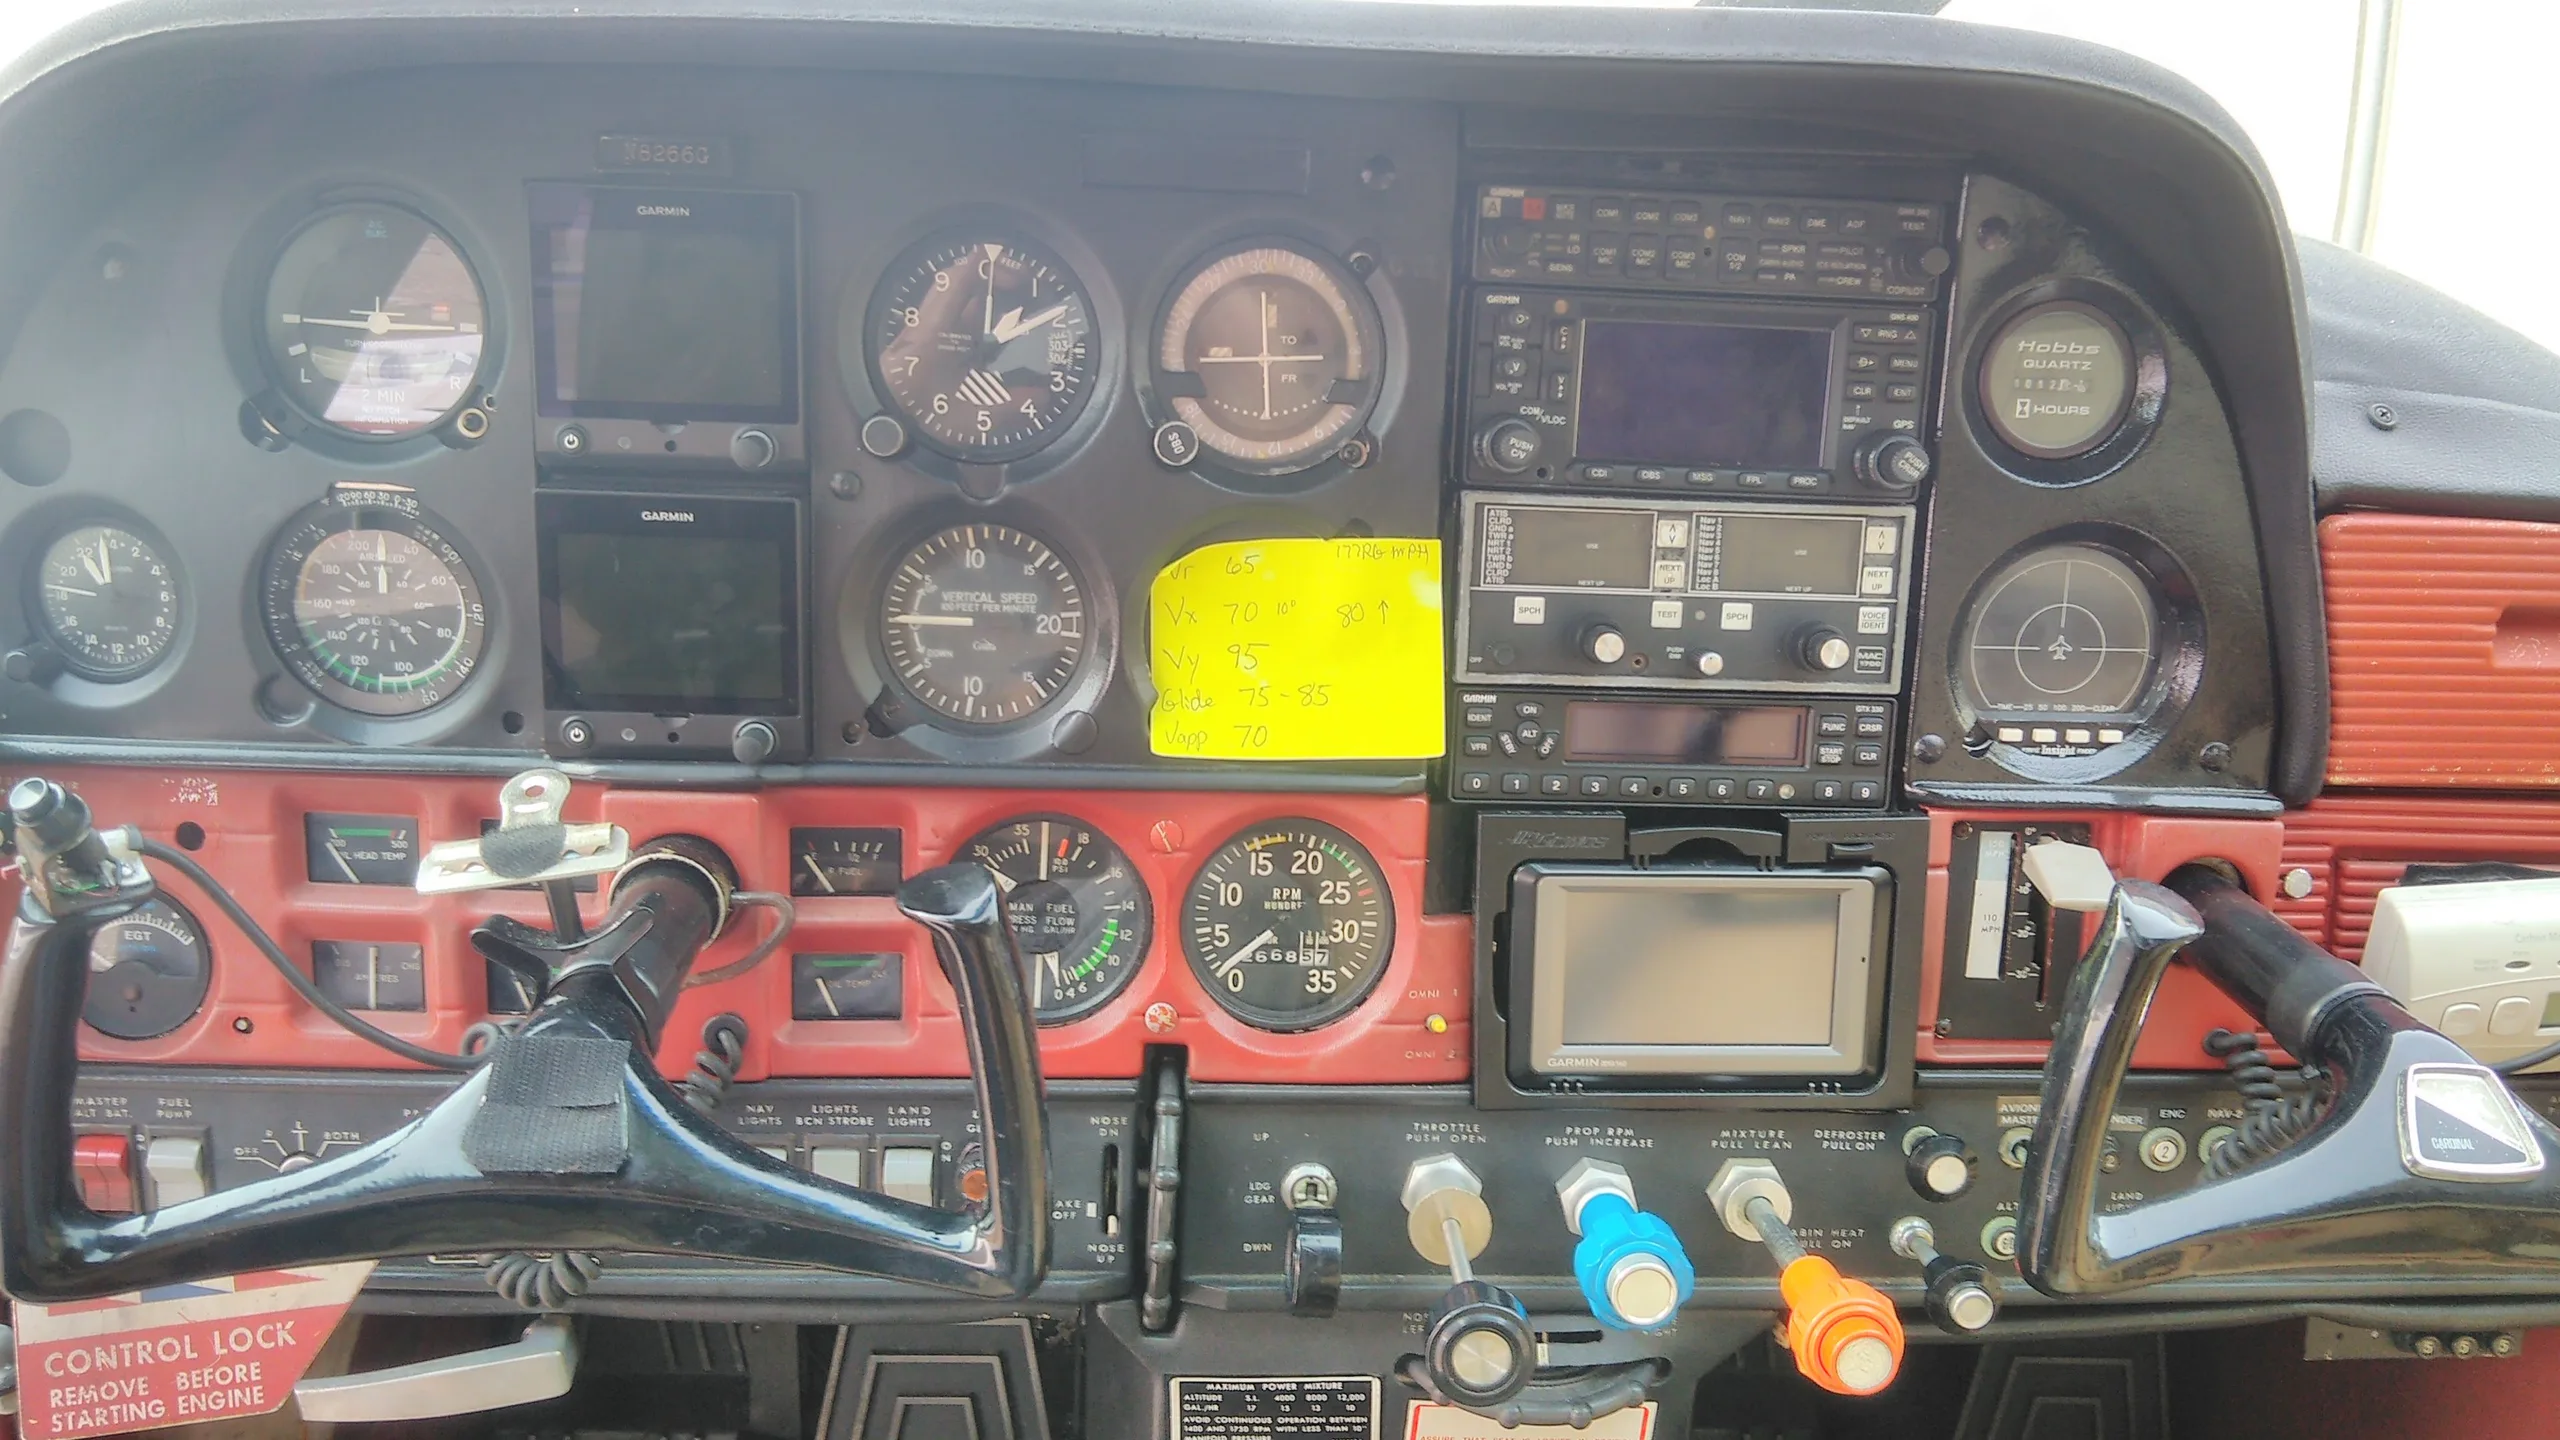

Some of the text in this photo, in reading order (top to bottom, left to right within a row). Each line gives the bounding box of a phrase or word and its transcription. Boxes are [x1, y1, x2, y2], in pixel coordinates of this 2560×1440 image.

[624, 142, 710, 164] N8266G
[637, 205, 690, 216] GARMIN
[935, 271, 950, 292] 9
[904, 308, 920, 327] 8
[1280, 336, 1297, 345] TO
[2017, 340, 2102, 355] Hobbs
[904, 357, 920, 376] 7
[2023, 359, 2093, 371] QUARTZ
[301, 368, 312, 383] L
[1281, 374, 1298, 383] FR
[450, 376, 461, 390] R
[1050, 372, 1066, 392] 3
[377, 390, 405, 402] MIN
[933, 394, 949, 414] 6
[1020, 399, 1037, 418] 4
[2033, 404, 2091, 416] HOURS
[976, 411, 992, 431] 5
[1893, 419, 1915, 430] GPS
[1793, 476, 1818, 487] PROC
[641, 511, 695, 523] GARMIN
[1489, 509, 1508, 517] ATIS
[965, 549, 985, 569] 10
[322, 565, 340, 574] 180
[1225, 555, 1260, 575] 65
[1659, 564, 1682, 572] NEXT
[60, 566, 77, 577] 20
[1867, 571, 1889, 579] NEXT
[160, 591, 169, 602] 6
[942, 592, 1038, 604] VERTICAL SPEED
[313, 599, 332, 608] 160
[1002, 605, 1036, 613] MINUTE
[1164, 596, 1198, 627] Vx
[1223, 601, 1259, 625] 70
[1518, 606, 1541, 615] SPCH
[1336, 604, 1365, 628] 80
[1657, 611, 1678, 619] TEST
[1726, 612, 1749, 621] SPCH
[1861, 611, 1887, 620] VOICE
[1036, 616, 1062, 634] 20
[1861, 621, 1886, 630] IDENT
[351, 656, 369, 666] 120
[1858, 652, 1882, 660] MAC
[394, 662, 413, 672] 100
[1162, 643, 1270, 685] Vy 95
[1858, 659, 1882, 668] 1700
[964, 676, 983, 695] 10
[1161, 688, 1216, 713] Glide
[1238, 685, 1273, 707] 75
[1297, 682, 1332, 708] 85
[1463, 694, 1497, 704] GARMIN
[1523, 706, 1537, 714] ON
[1467, 714, 1492, 722] IDENT
[1821, 723, 1846, 732] FUNC
[1859, 724, 1883, 732] CRSR
[1165, 721, 1268, 752] Vapp 70
[1522, 729, 1538, 738] ALT
[1470, 743, 1488, 751] VFR
[1500, 733, 1517, 755] STBY
[2041, 744, 2076, 758] Insight
[1860, 752, 1878, 761] CLR
[1718, 784, 1727, 795] 6
[1014, 825, 1030, 836] 35
[1077, 832, 1090, 844] 18
[391, 840, 408, 849] 500
[353, 851, 407, 860] HEAD TEMP
[1250, 852, 1273, 876] 15
[1291, 850, 1324, 874] 20
[1219, 882, 1243, 907] 10
[1273, 888, 1302, 900] RPM
[1318, 880, 1351, 905] 25
[1046, 904, 1075, 914] FUEL
[1121, 900, 1135, 911] 14
[1045, 916, 1075, 926] FLOW
[1983, 914, 1998, 922] 110
[1329, 919, 1360, 944] 30
[1981, 925, 2001, 933] MPH
[124, 930, 152, 941] EGT
[1119, 929, 1133, 941] 12
[1214, 923, 1230, 948] 5
[1095, 971, 1105, 983] 8
[1227, 968, 1244, 993] 0
[1305, 969, 1337, 994] 35
[1078, 981, 1088, 994] 6
[1409, 989, 1440, 999] OMNI
[1547, 1057, 1600, 1067] GARMIN
[76, 1097, 128, 1107] MASTER
[158, 1098, 192, 1108] FUEL
[155, 1109, 193, 1119] PUMP
[746, 1105, 775, 1114] NAV
[811, 1104, 859, 1114] LIGHTS
[888, 1106, 932, 1116] LAND
[2159, 1109, 2186, 1119] ENC
[2208, 1109, 2244, 1119] NAV-2
[737, 1116, 783, 1126] LIGHTS
[795, 1117, 875, 1126] BCN STROBE
[888, 1117, 932, 1127] LIGHTS
[1090, 1115, 1129, 1126] NOSE
[1413, 1122, 1481, 1133] THROTTLE
[1565, 1127, 1635, 1137] PROP RPM
[323, 1131, 360, 1141] BOTH
[1253, 1133, 1270, 1142] UP
[1406, 1134, 1488, 1144] PUSH OPEN
[1720, 1129, 1786, 1140] MIXTURE
[1813, 1129, 1886, 1140] DEFROSTER
[1545, 1137, 1655, 1149] PUSH INCREASE
[1711, 1140, 1793, 1150] PULL LEAN
[1822, 1141, 1876, 1151] PULL ON
[2431, 1137, 2475, 1150] CARDINAL
[1250, 1181, 1272, 1191] LDG
[1244, 1195, 1275, 1205] GEAR
[1052, 1211, 1077, 1220] OFF
[1830, 1228, 1866, 1238] HEAT
[1087, 1244, 1125, 1254] NOSE
[1243, 1243, 1273, 1253] DWN
[1831, 1239, 1852, 1249] ON
[1096, 1255, 1115, 1264] UP
[44, 1321, 297, 1379] CONTROL LOCK
[50, 1361, 262, 1409] REMOVE BEFORE
[1206, 1383, 1255, 1391] MAXIMUM
[1303, 1382, 1343, 1390] MIXTURE
[1183, 1394, 1223, 1402] ALTITUDE
[1274, 1394, 1295, 1402] 4000
[51, 1385, 265, 1433] STARTING ENGINE
[1183, 1416, 1368, 1424] AVOID CONTINUOUS OPERATION BETWEEN
